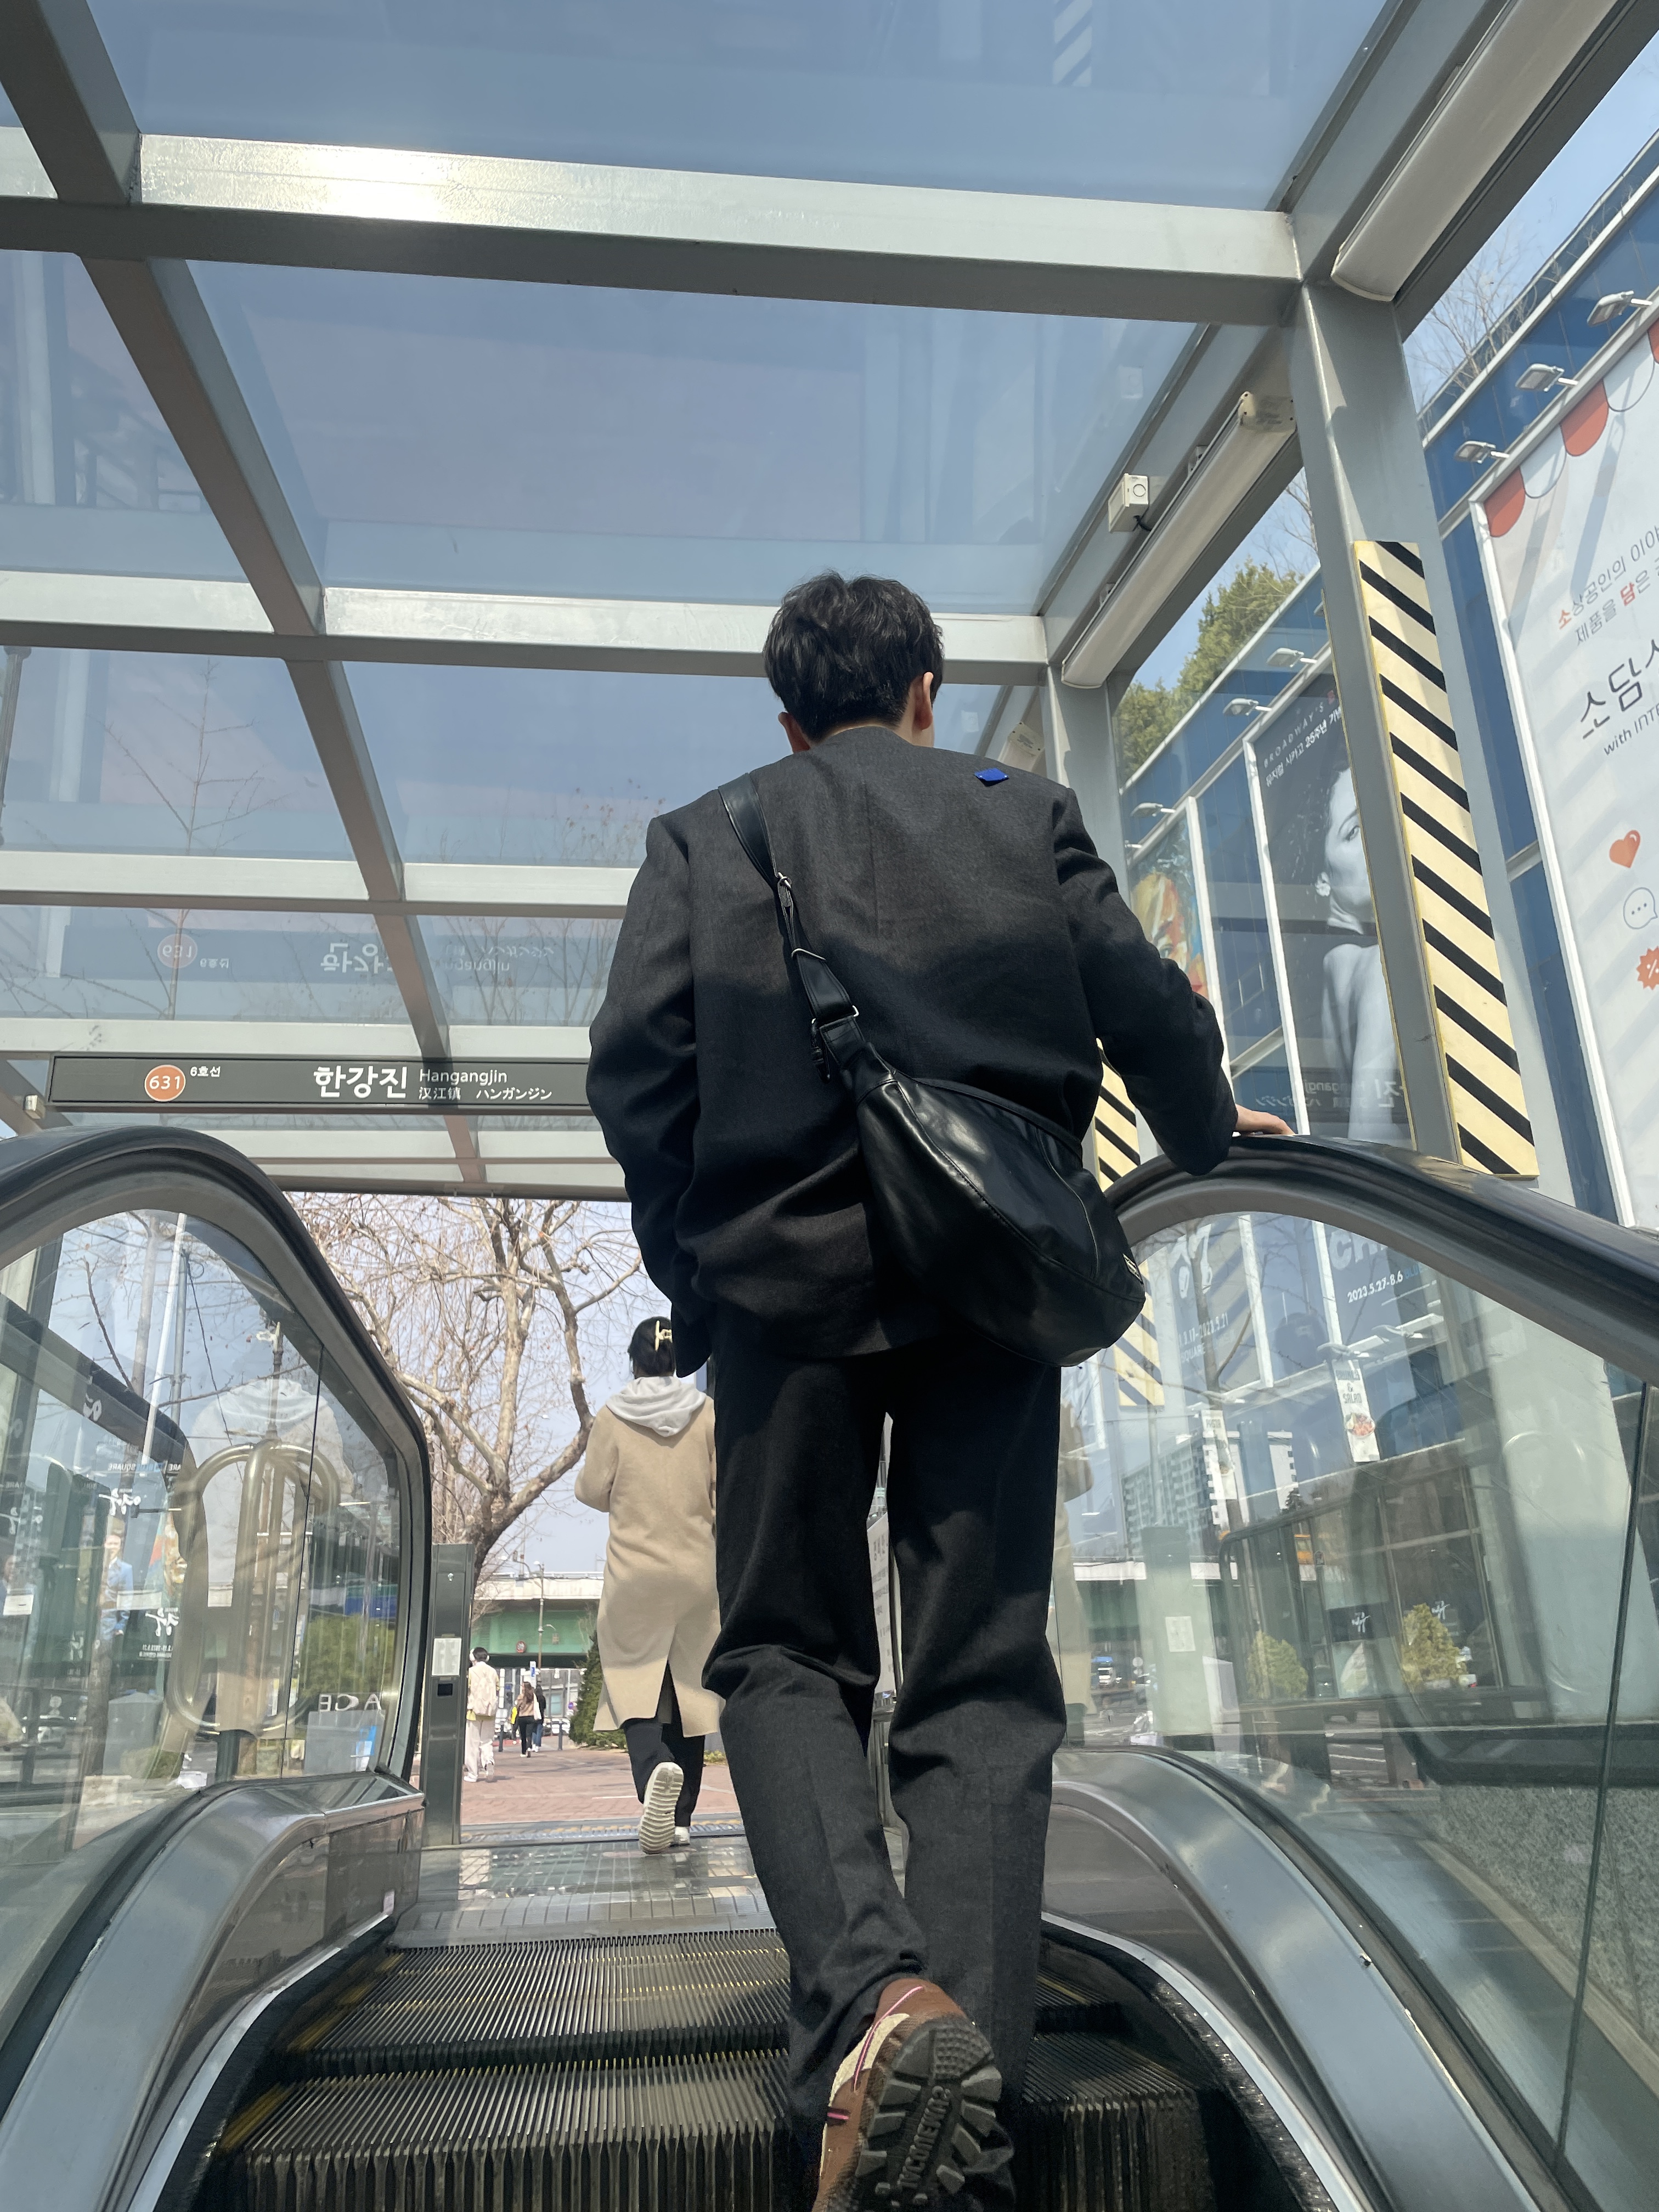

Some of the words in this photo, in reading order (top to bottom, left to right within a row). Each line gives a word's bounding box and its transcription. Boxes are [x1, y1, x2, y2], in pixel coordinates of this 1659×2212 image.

[1559, 555, 1626, 629] 소상공인의
[1575, 599, 1617, 646] 제품을
[1620, 569, 1651, 607] 담은
[1604, 729, 1632, 756] with
[1266, 761, 1284, 787] 뮤지컬
[1285, 742, 1305, 766] 시카고
[149, 1075, 180, 1090] 631
[190, 1066, 221, 1077] 6호선
[313, 1065, 408, 1098] 한강진
[419, 1069, 507, 1086] Hangangjin
[419, 1086, 461, 1101] 汉江镇
[476, 1087, 553, 1101] ハンガンジン
[1347, 1270, 1403, 1304] 2023.5.27-8.6
